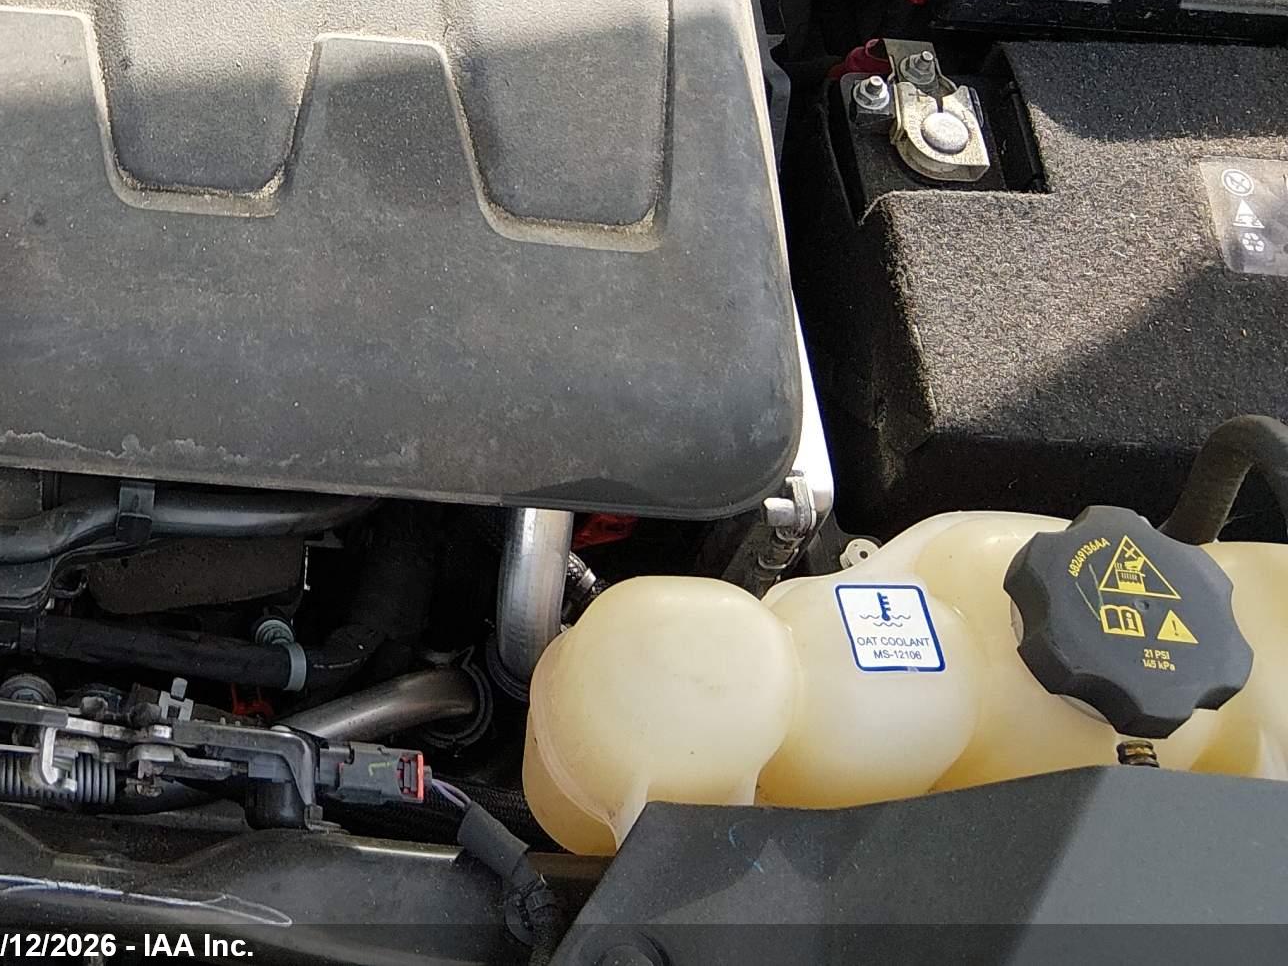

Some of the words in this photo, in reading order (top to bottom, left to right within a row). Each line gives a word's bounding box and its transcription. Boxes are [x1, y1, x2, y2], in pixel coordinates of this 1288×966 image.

[856, 636, 878, 647] OAT
[880, 636, 930, 647] COOLANT
[873, 649, 922, 660] MS-12106
